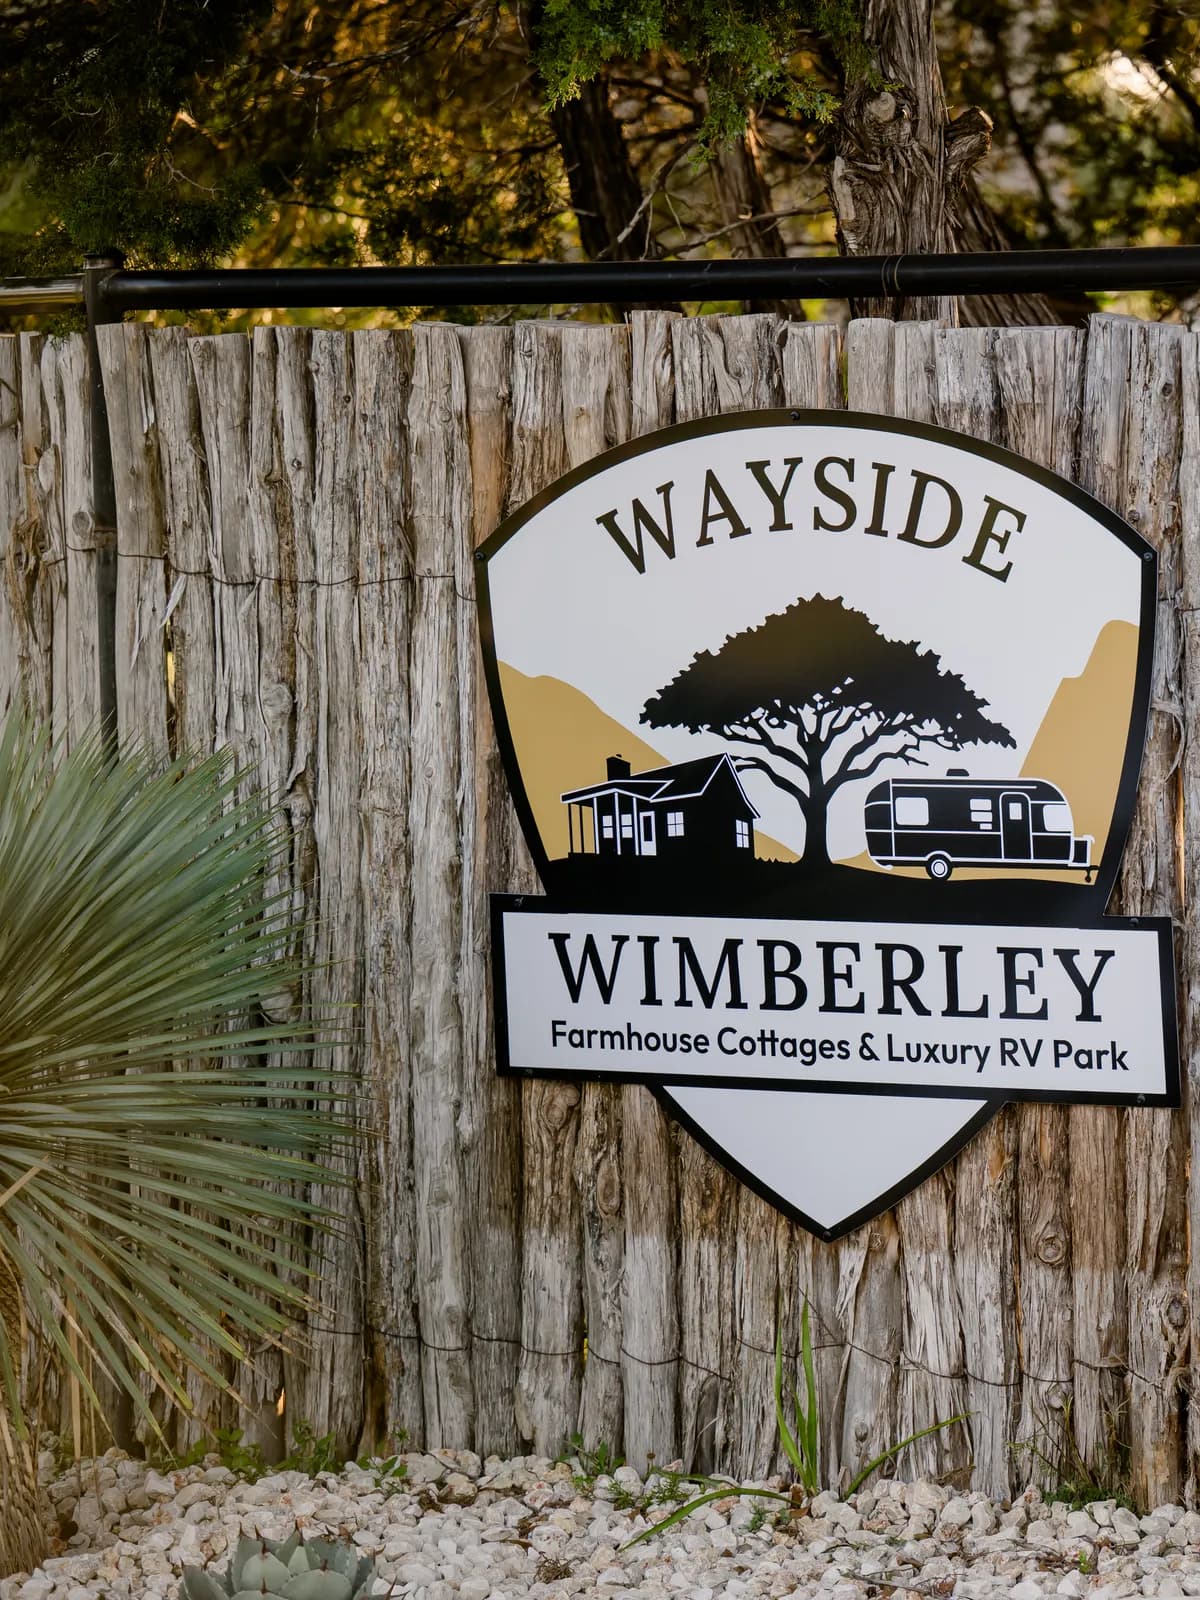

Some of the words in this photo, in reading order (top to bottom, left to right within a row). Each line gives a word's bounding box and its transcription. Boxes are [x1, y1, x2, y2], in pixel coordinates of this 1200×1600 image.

[596, 457, 1027, 583] WAYSIDE
[548, 933, 1115, 1022] WIMBERLEY
[552, 1020, 709, 1054] Farmhouse
[717, 1027, 850, 1066] Cottages
[859, 1033, 880, 1061] &
[887, 1034, 990, 1073] Luxury
[1000, 1038, 1043, 1067] RV
[1054, 1040, 1129, 1070] Park
